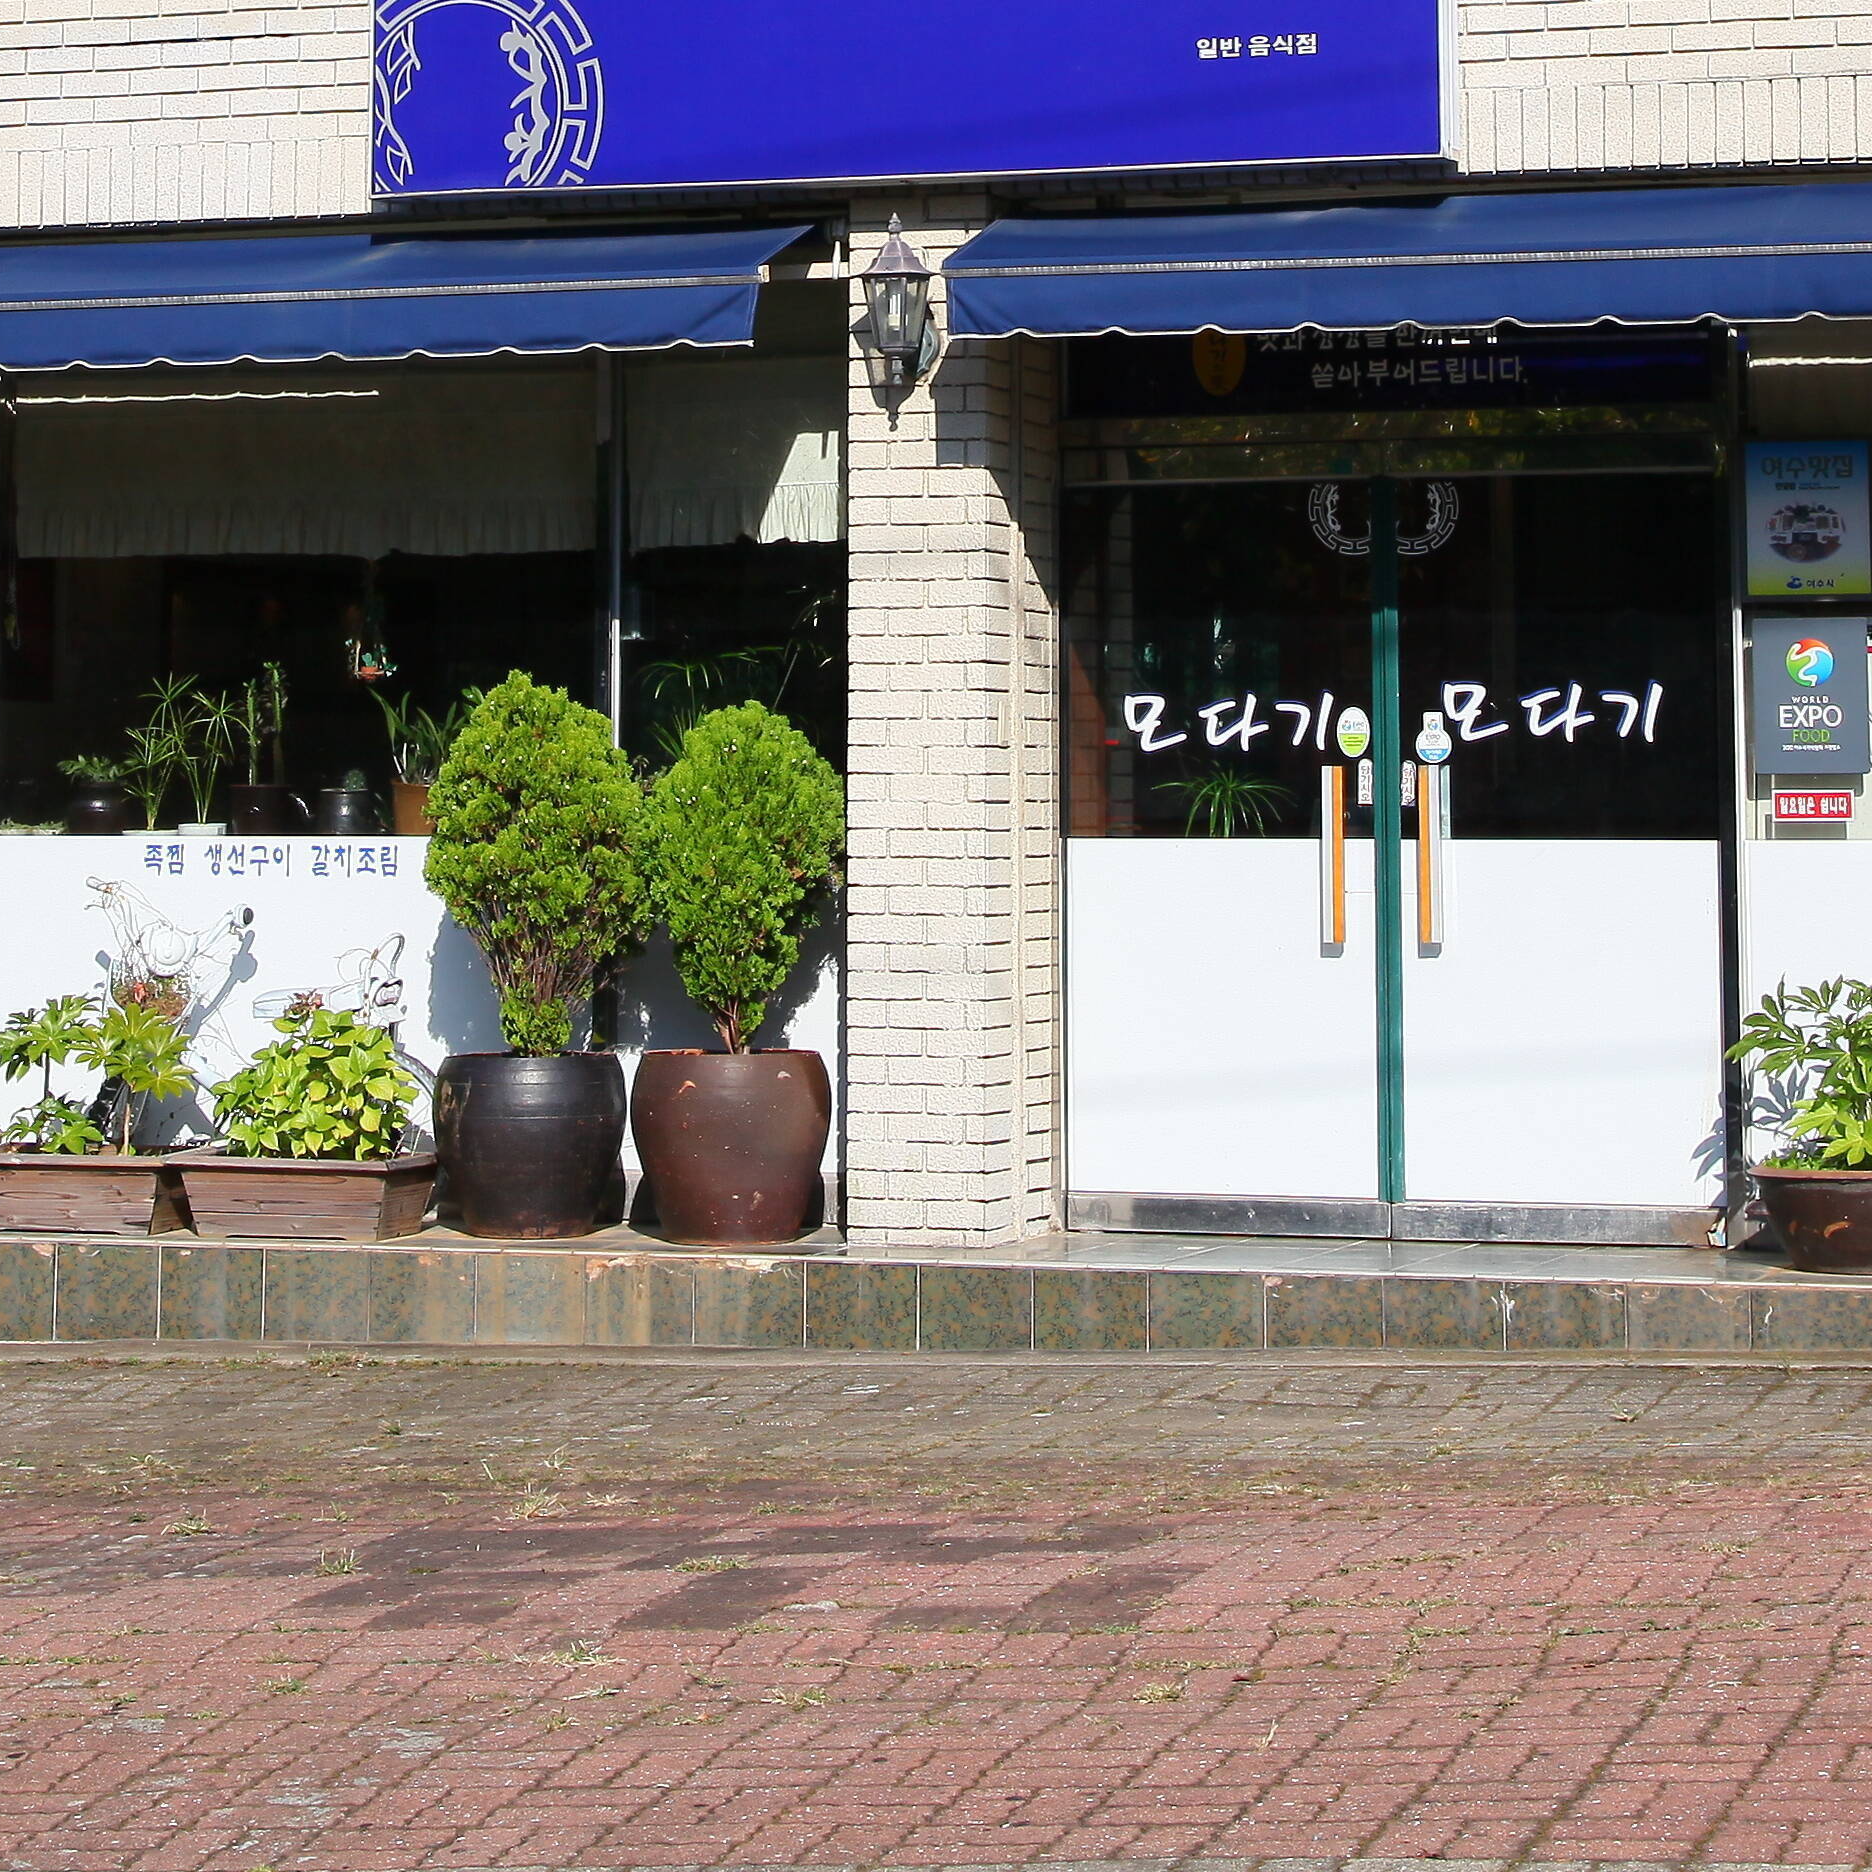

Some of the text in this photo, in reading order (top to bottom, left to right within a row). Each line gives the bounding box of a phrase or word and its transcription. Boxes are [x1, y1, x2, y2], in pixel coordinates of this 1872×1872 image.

[1195, 33, 1318, 59] 일반 음식점
[1760, 455, 1853, 479] 여수맛집
[1791, 695, 1829, 704] WORLD
[1778, 704, 1843, 728] EXPO
[1792, 729, 1830, 743] FOOD
[1780, 796, 1816, 815] 일요일은
[144, 843, 398, 878] 족찜 생선구이 갈치조림
